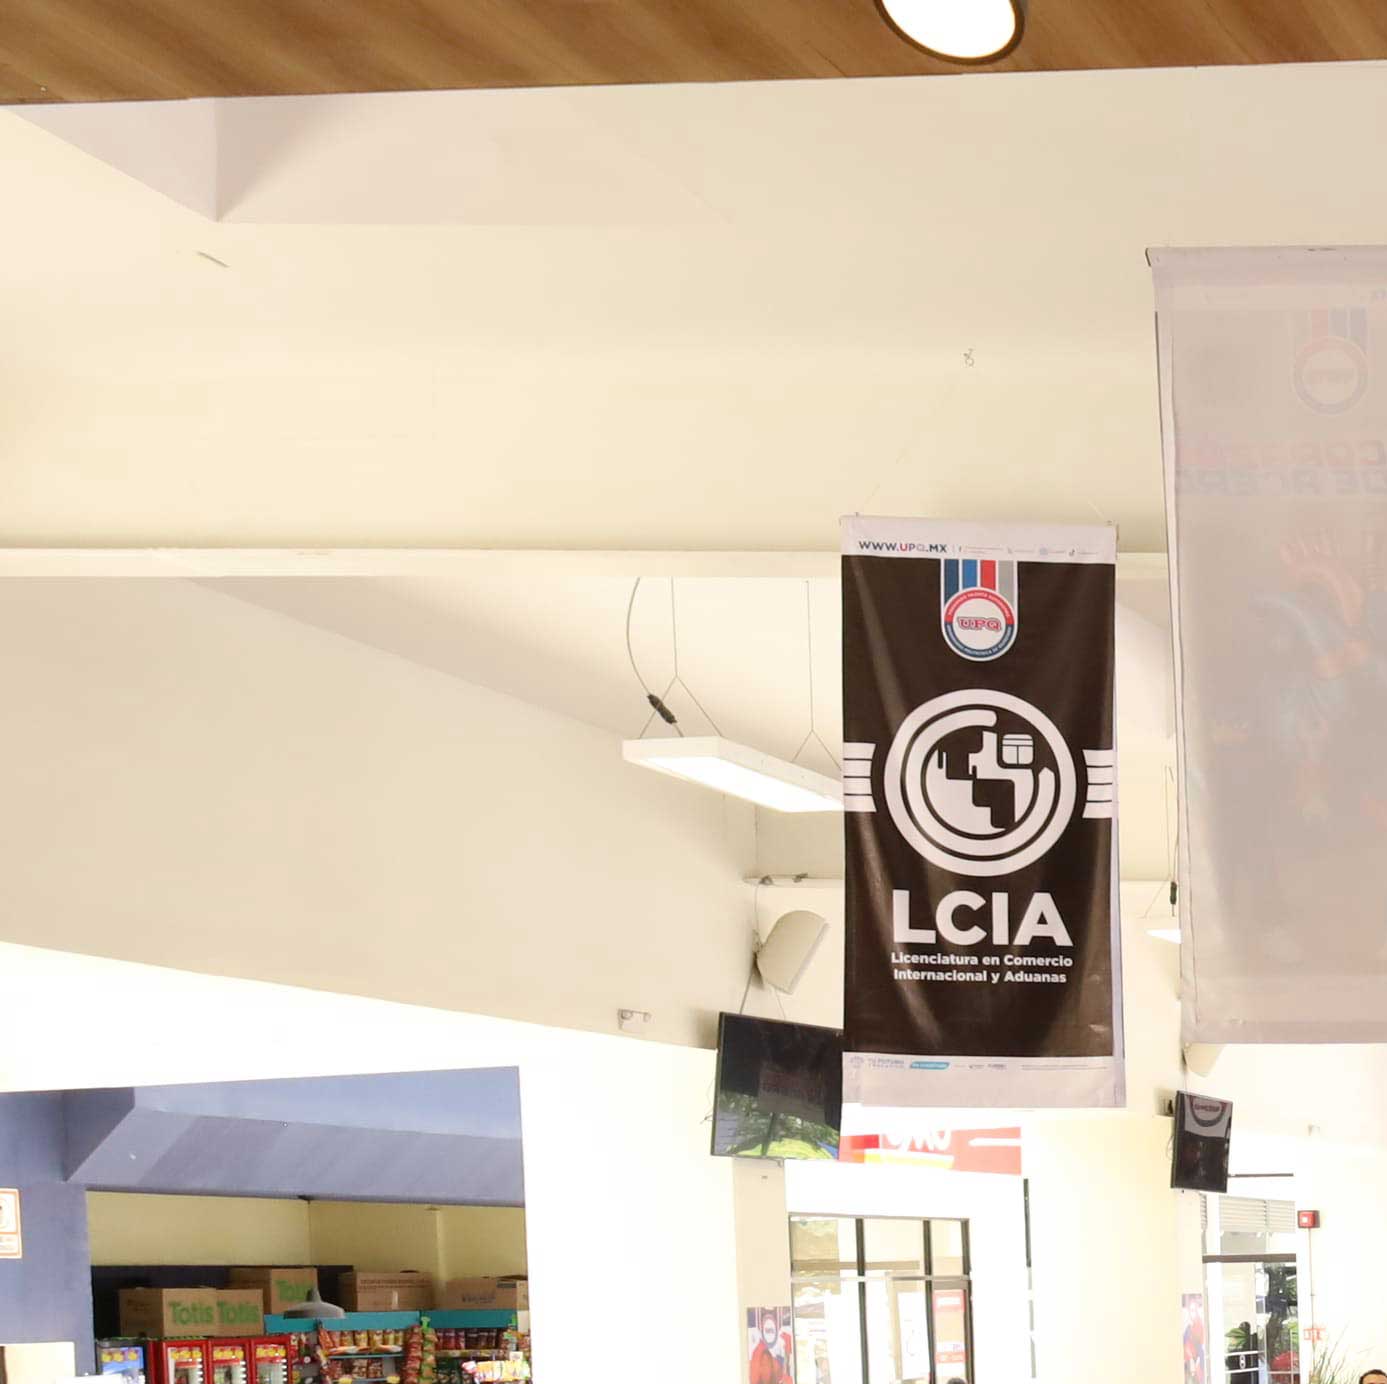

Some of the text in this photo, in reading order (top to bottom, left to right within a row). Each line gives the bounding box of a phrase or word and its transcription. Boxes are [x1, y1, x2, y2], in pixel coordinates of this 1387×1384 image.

[859, 540, 947, 553] WWW.UPQ.MX
[958, 617, 1002, 634] UPQ
[892, 889, 1074, 947] LCIA
[891, 952, 1073, 968] Licenciatura en Comercio
[894, 970, 1067, 985] Internacional y Aduanas
[169, 1301, 214, 1325] Totis
[217, 1300, 259, 1324] Totis
